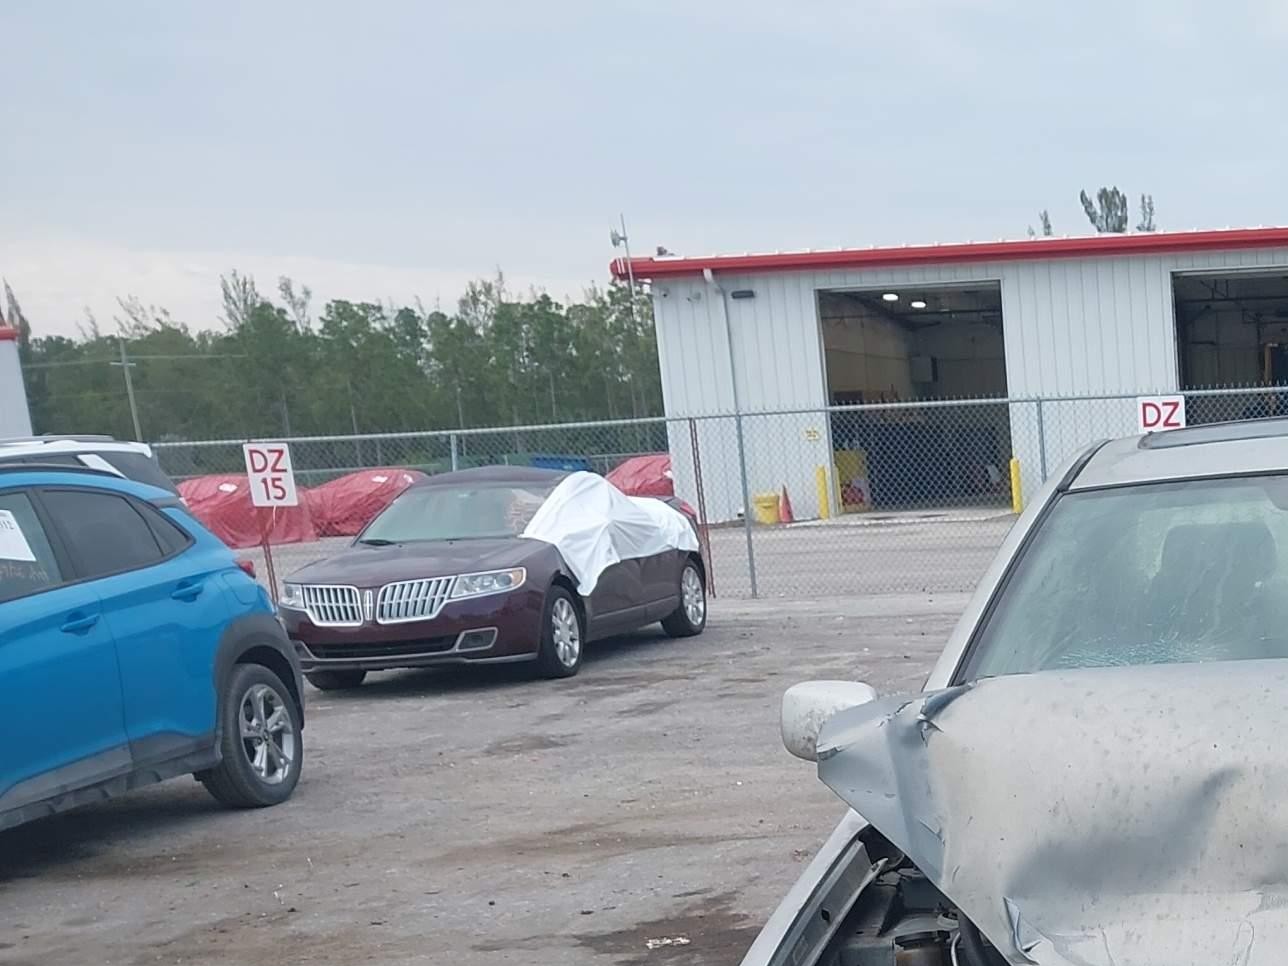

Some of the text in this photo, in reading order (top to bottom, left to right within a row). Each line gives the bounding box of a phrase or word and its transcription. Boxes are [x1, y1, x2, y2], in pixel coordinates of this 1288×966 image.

[1142, 402, 1180, 427] DZ
[248, 449, 288, 473] DZ
[261, 477, 287, 501] 15
